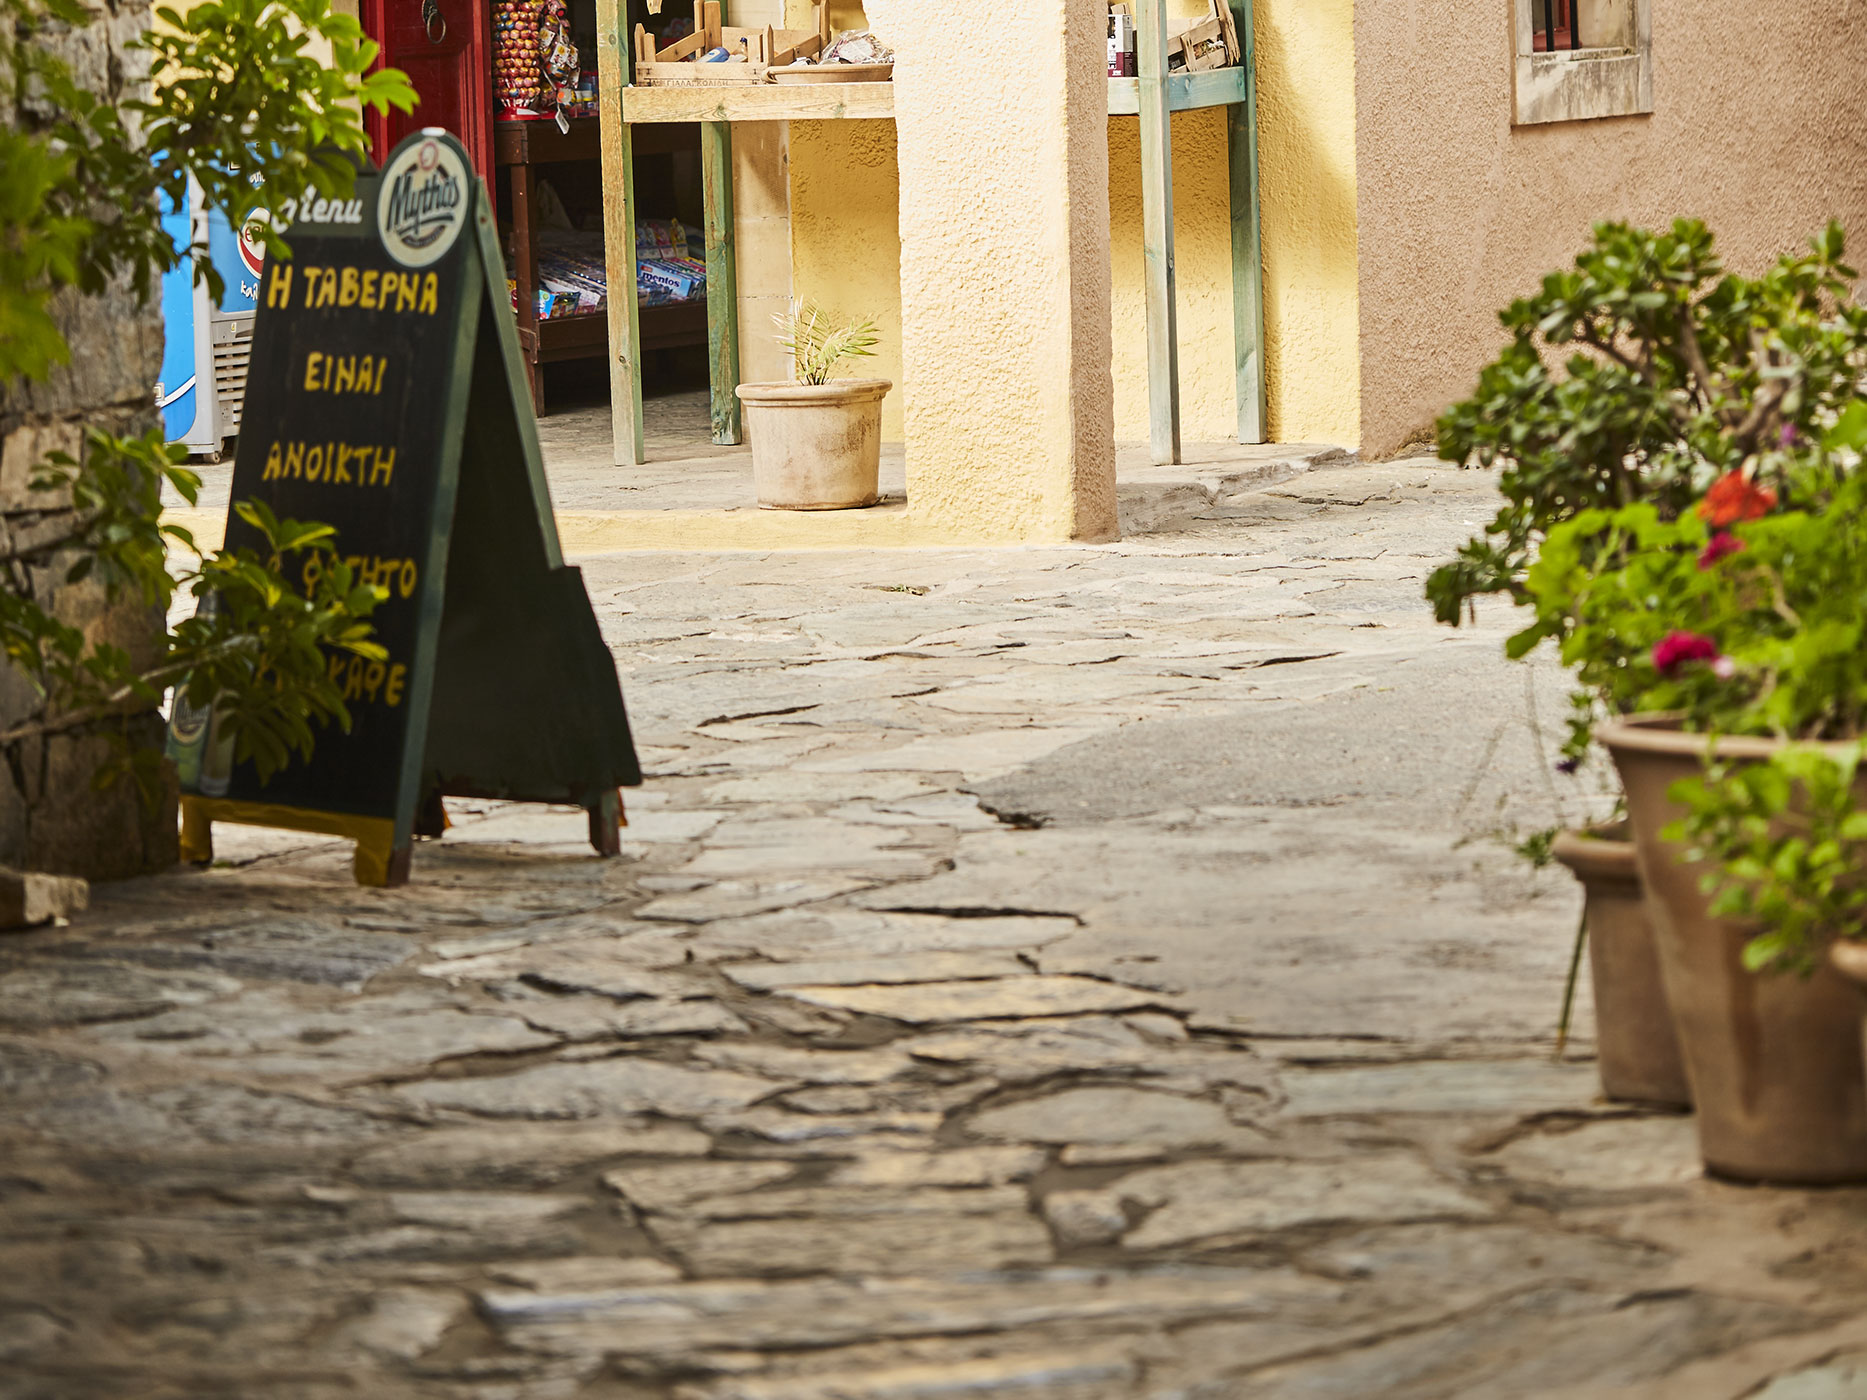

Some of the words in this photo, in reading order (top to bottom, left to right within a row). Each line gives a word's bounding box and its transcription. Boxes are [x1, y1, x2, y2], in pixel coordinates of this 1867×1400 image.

[386, 171, 461, 234] Mythos
[267, 264, 293, 310] Η
[303, 266, 439, 316] ΤΑΒΕΡΝΑ
[642, 272, 681, 288] mentos
[304, 351, 388, 395] ΕΙΝΑΙ
[262, 441, 397, 487] ΑΝΟΙΚΤΗ
